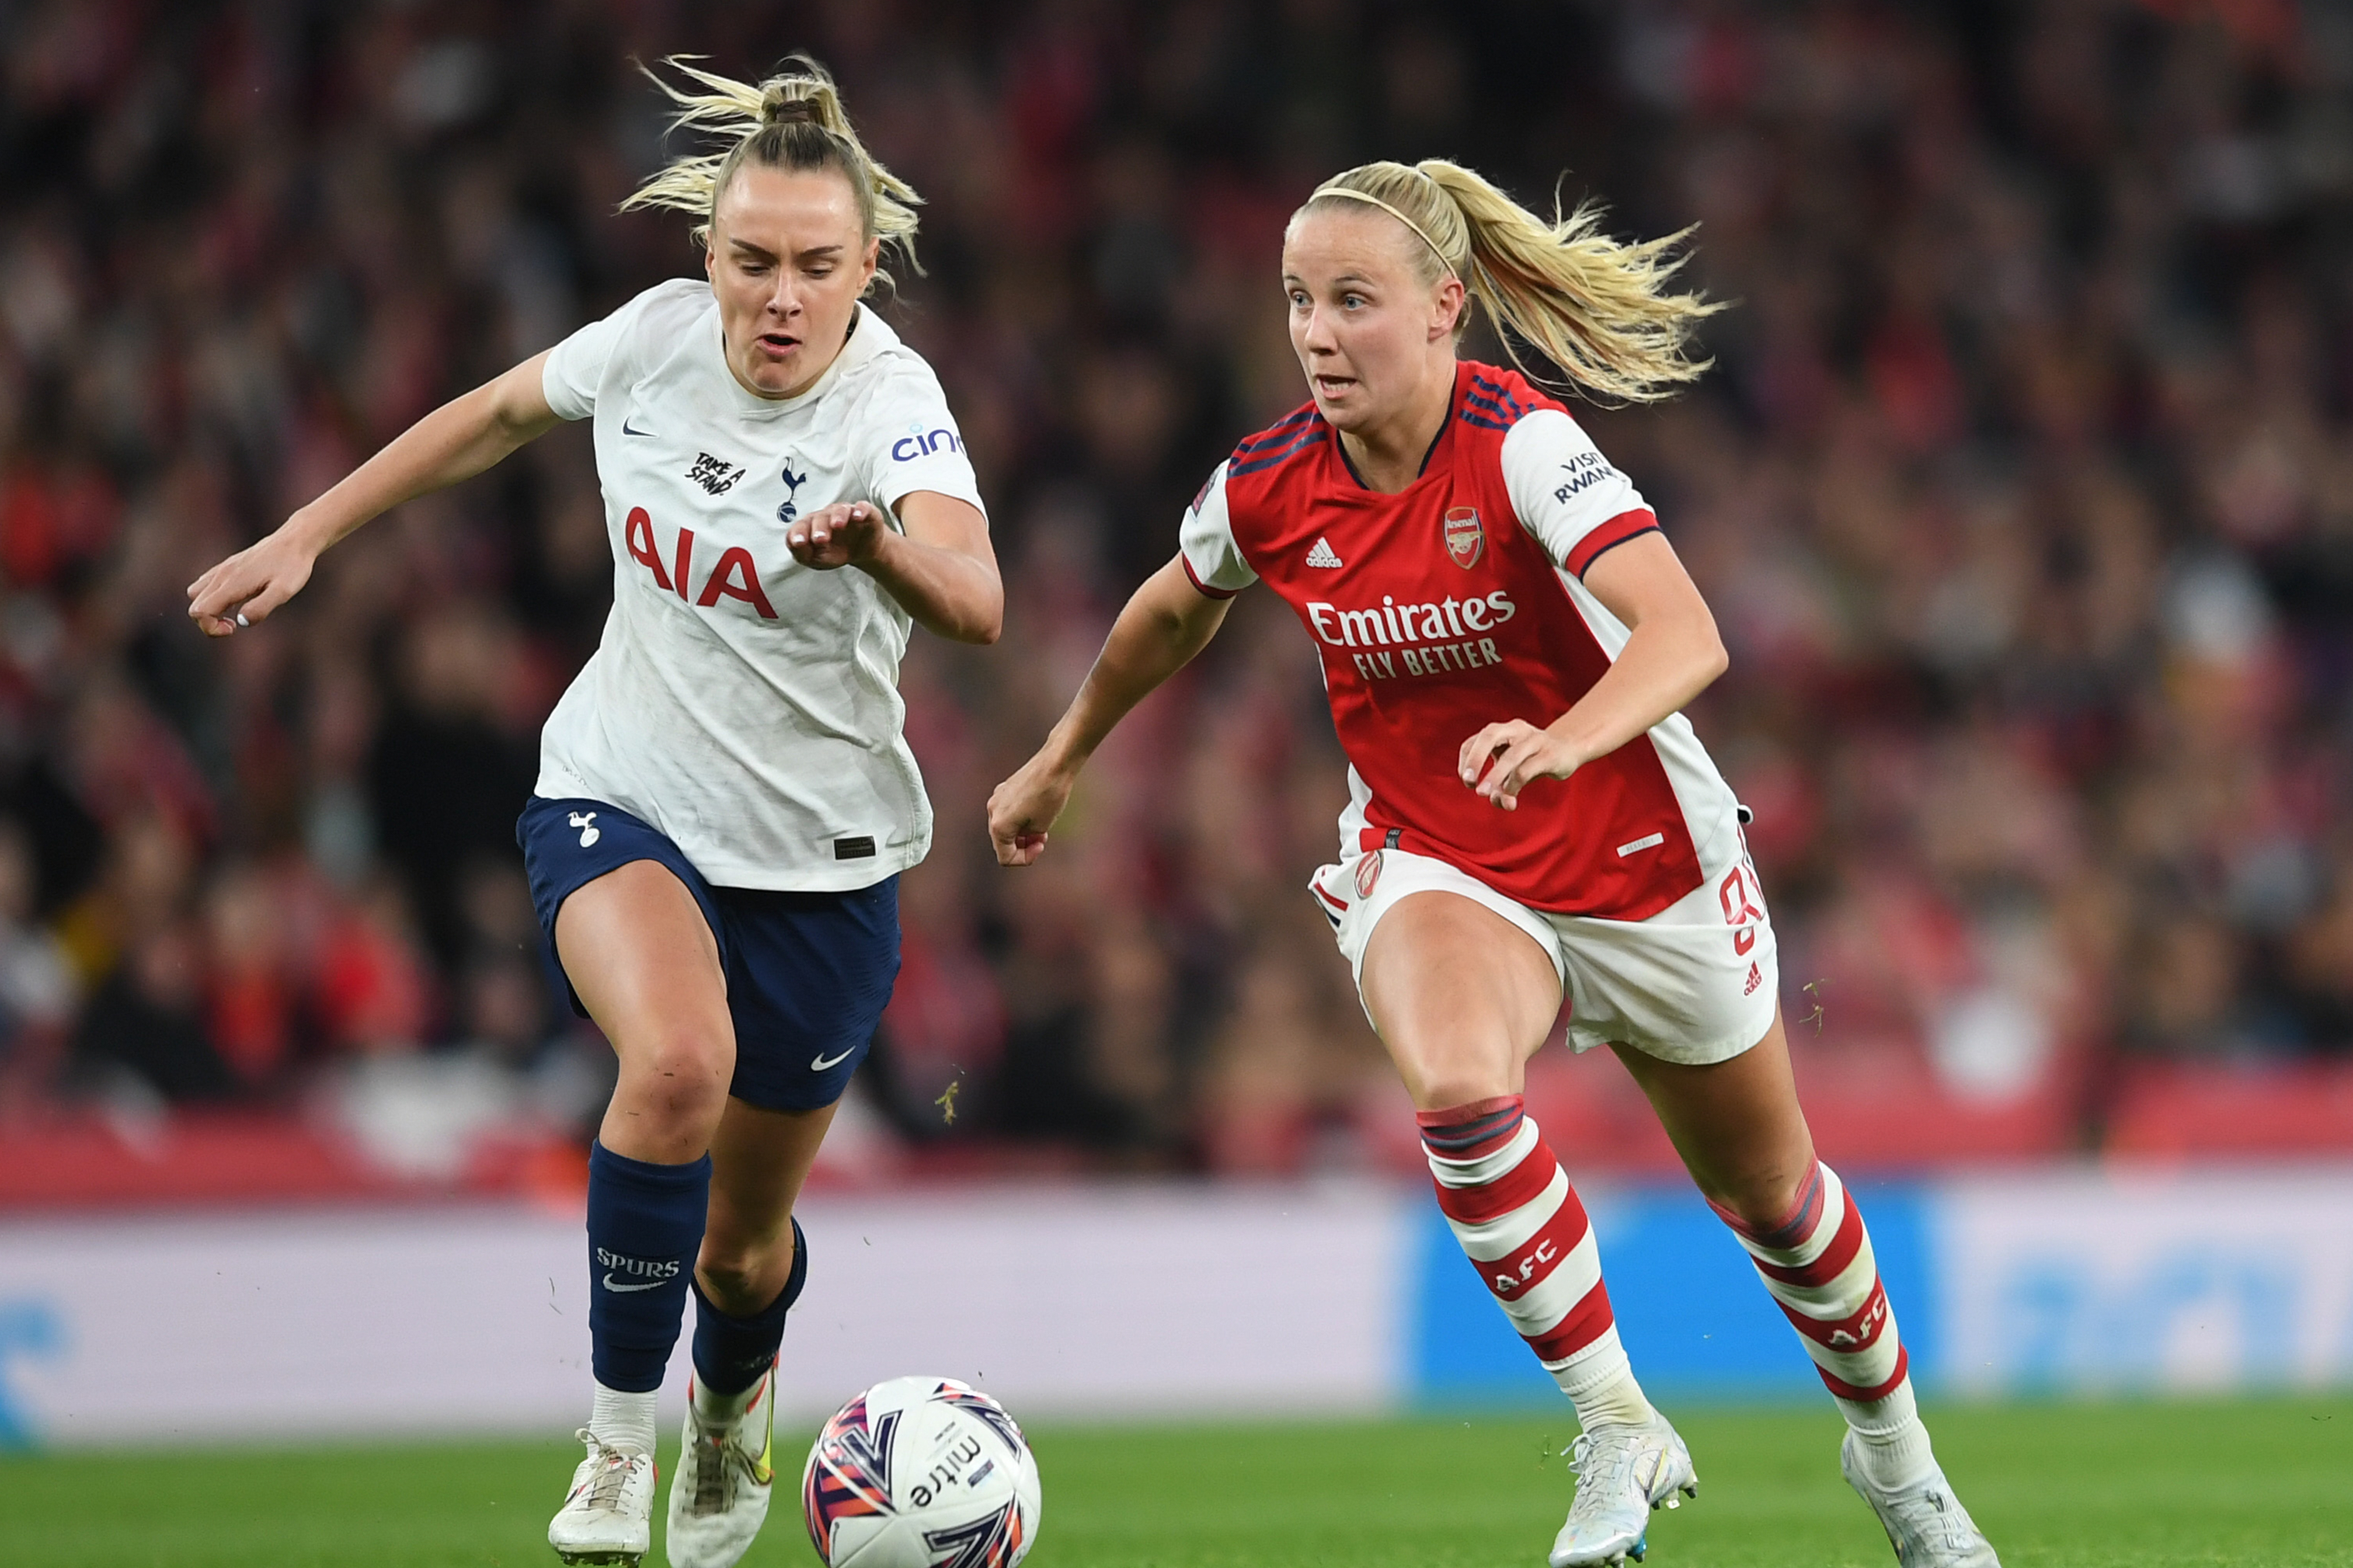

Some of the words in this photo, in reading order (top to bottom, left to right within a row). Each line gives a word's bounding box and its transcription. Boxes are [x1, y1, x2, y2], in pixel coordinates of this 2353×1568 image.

[695, 452, 733, 476] TAKE
[729, 468, 747, 483] A
[625, 506, 779, 619] AIA
[1306, 556, 1343, 568] adidas
[1306, 590, 1516, 647] Emirates
[1352, 651, 1397, 680] FLY
[1401, 637, 1503, 676] BETTER
[597, 1246, 680, 1278] SPURS
[1496, 1238, 1558, 1292] AFC
[1828, 1293, 1885, 1344] AFC
[910, 1435, 981, 1507] mitre
